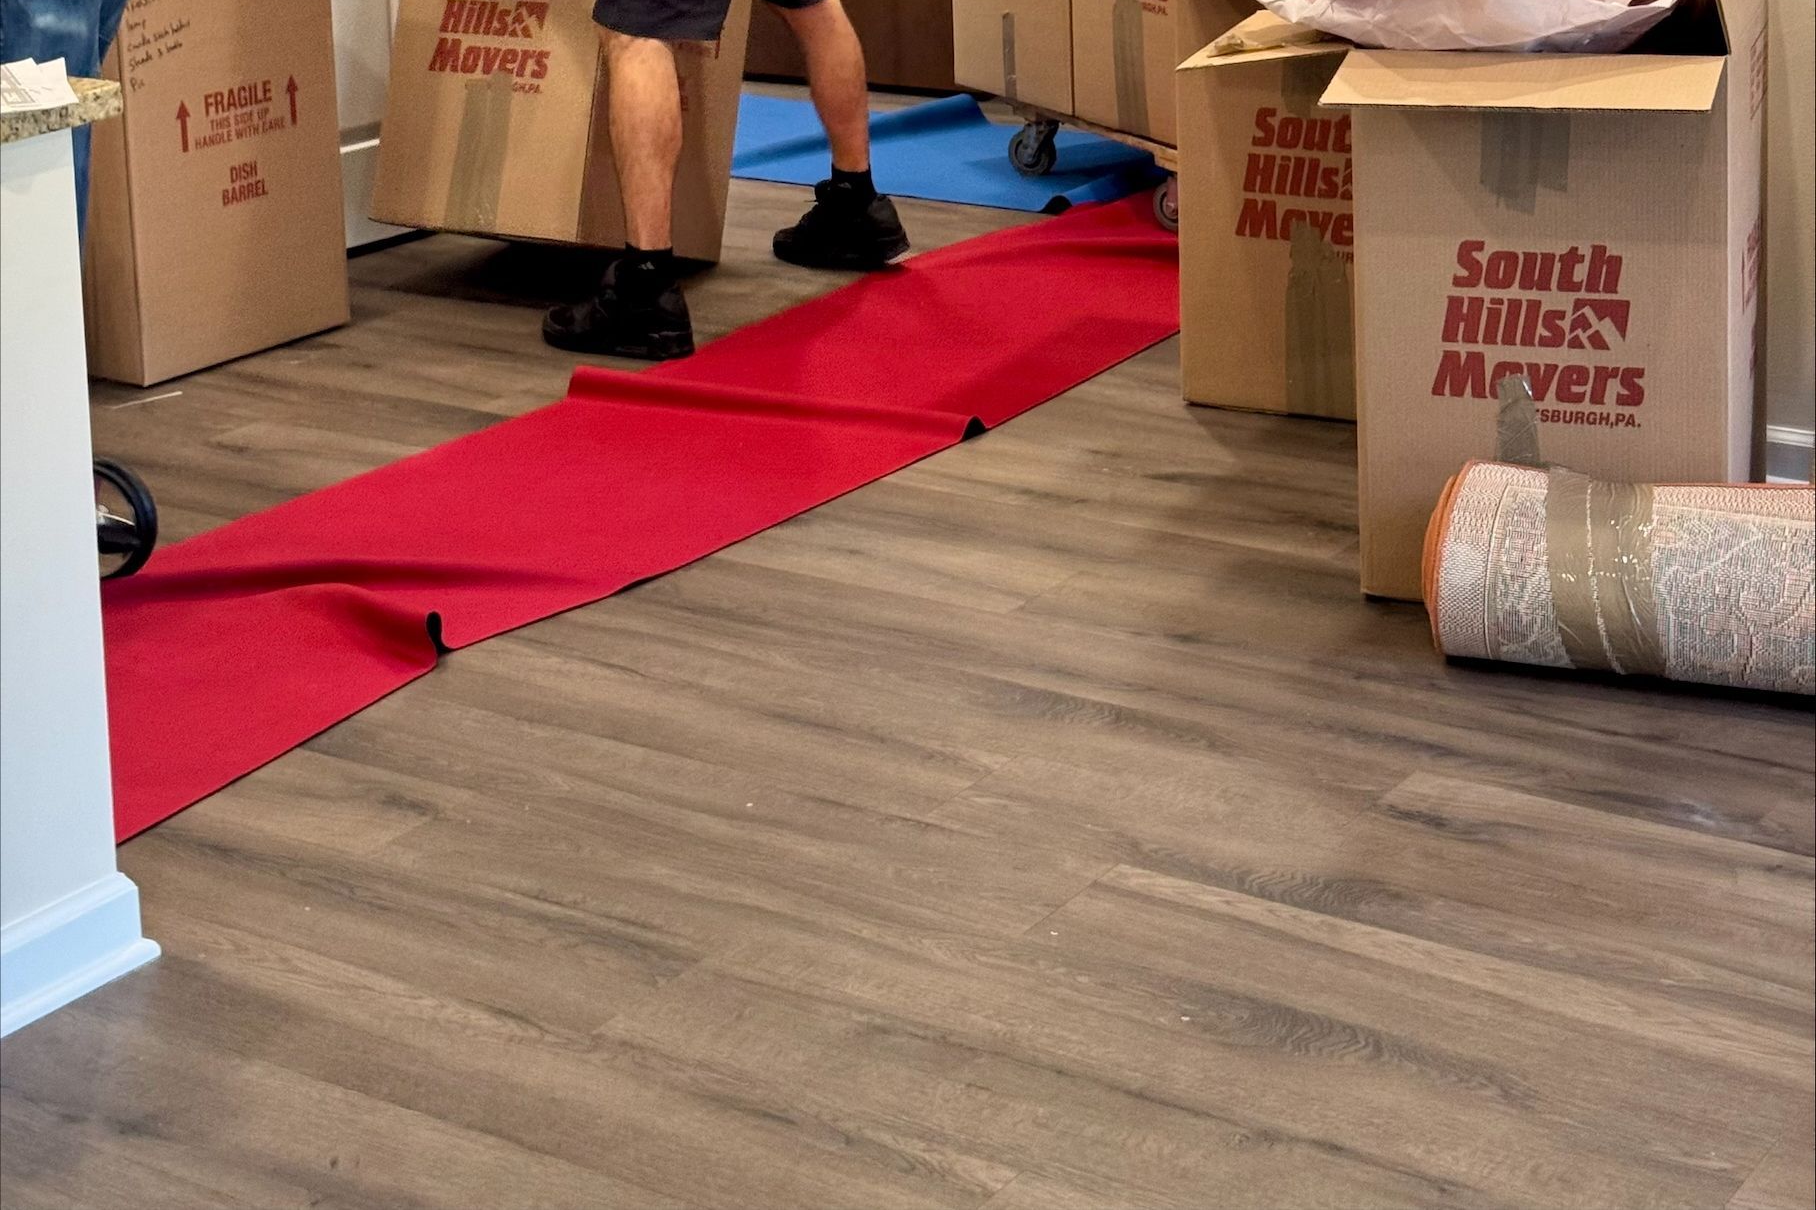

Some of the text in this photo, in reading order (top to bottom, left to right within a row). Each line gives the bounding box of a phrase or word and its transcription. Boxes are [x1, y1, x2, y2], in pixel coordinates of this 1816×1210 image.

[428, 37, 551, 79] Movers
[203, 79, 273, 118] FRAGILE
[195, 116, 286, 150] HANDLE WITH CARE
[210, 107, 270, 131] THIS SIDE UP
[1251, 106, 1352, 153] Sout
[229, 160, 258, 184] DISH
[1243, 153, 1339, 199] Hills
[222, 178, 269, 207] BARREL
[1235, 198, 1354, 247] Move
[1452, 239, 1623, 294] South
[1441, 295, 1566, 348] Hills
[1536, 407, 1642, 429] SBURGH,PA.
